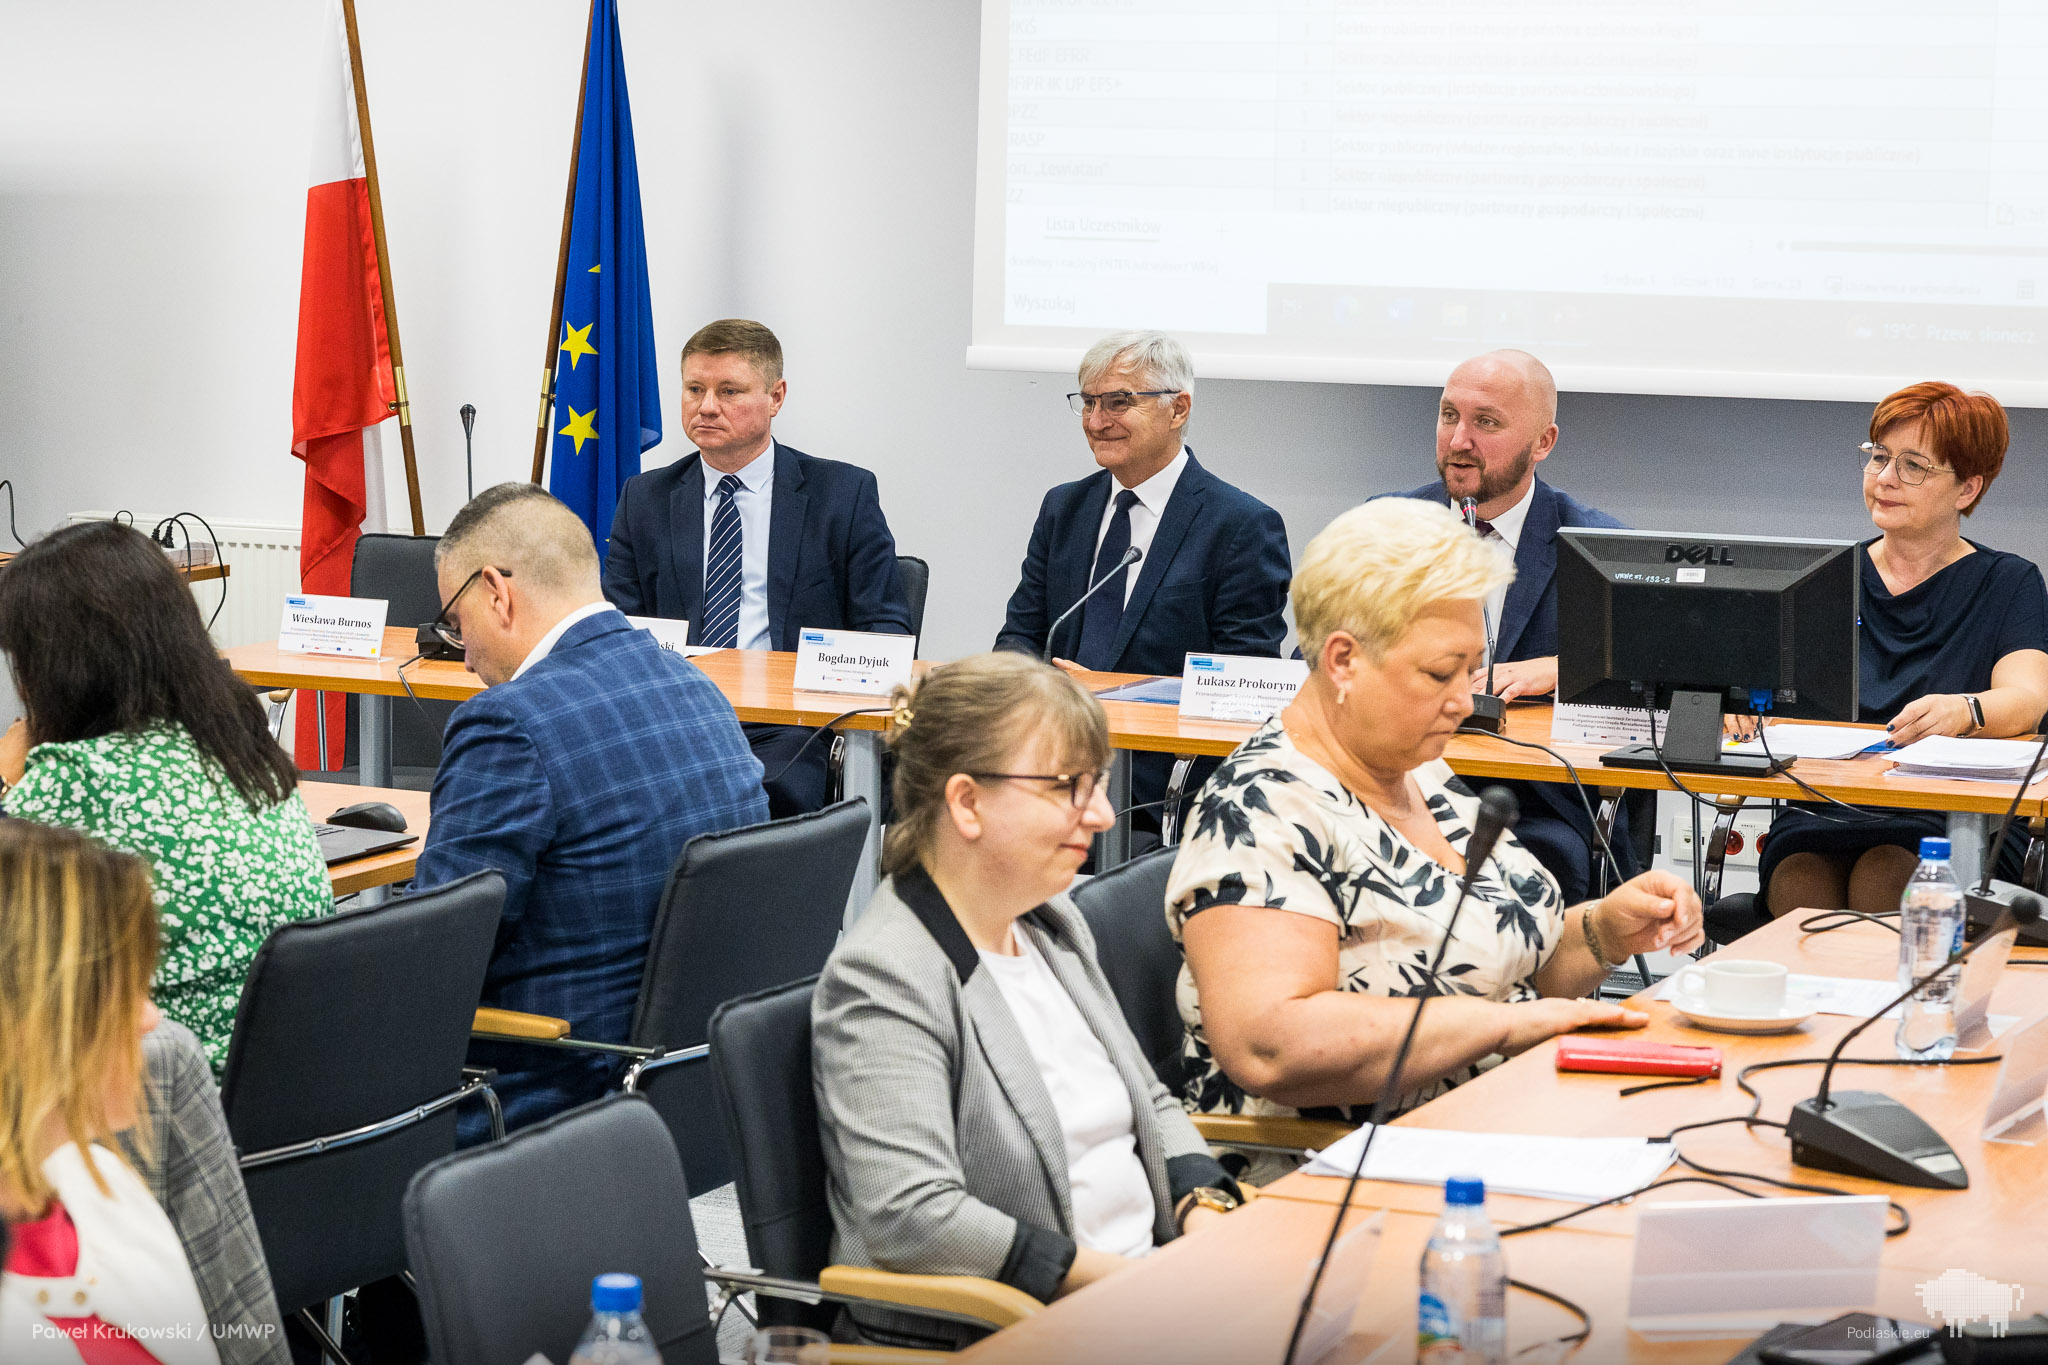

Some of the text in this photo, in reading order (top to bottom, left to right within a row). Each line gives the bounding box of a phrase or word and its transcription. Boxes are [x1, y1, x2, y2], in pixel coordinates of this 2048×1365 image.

[1065, 77, 1085, 91] UP
[1334, 137, 1375, 153] Sektor
[1378, 139, 1443, 157] publiczny
[1703, 147, 1735, 160] oraz
[1332, 197, 1374, 211] Sektor
[1377, 197, 1460, 216] niepubliczny
[1537, 201, 1624, 220] gospodarczy
[1046, 216, 1076, 231] Lista
[1012, 294, 1076, 314] Wyszukaj
[1665, 543, 1735, 567] DELL
[292, 613, 372, 629] Wiesława Burnos
[657, 641, 675, 652] ski
[818, 652, 890, 668] Bogdan Dyjuk
[1197, 675, 1297, 693] Łukasz Prokorym
